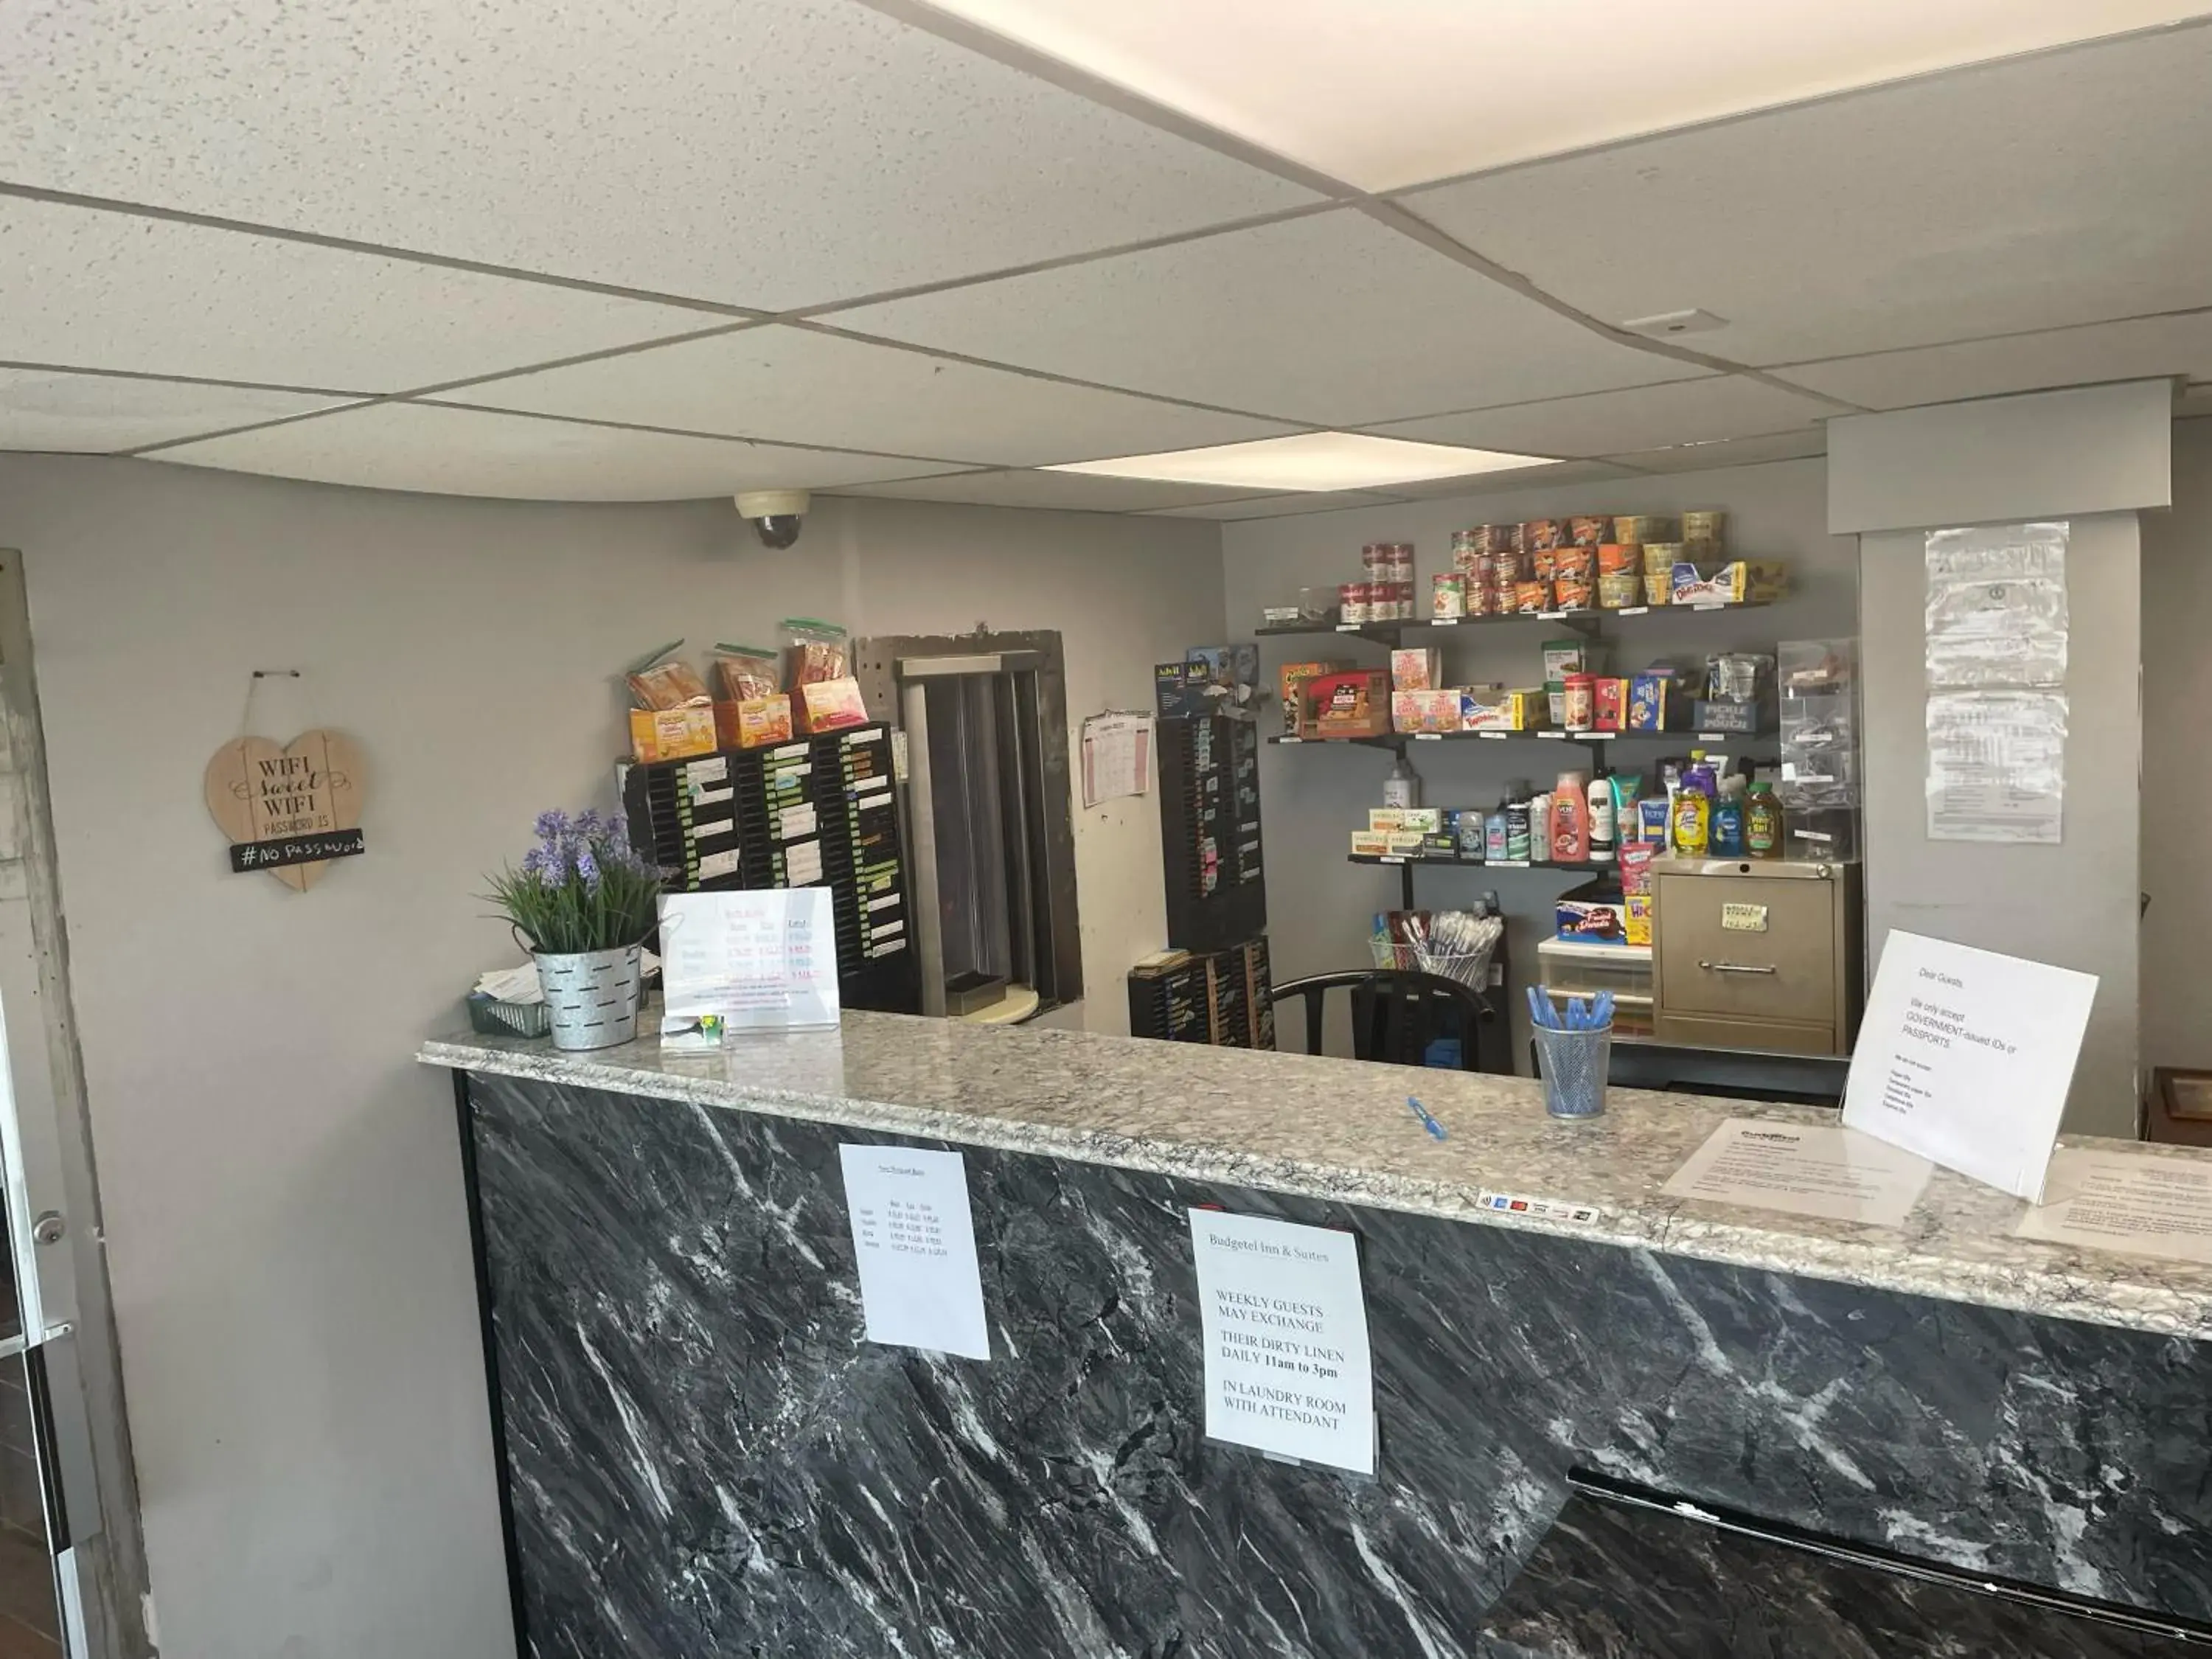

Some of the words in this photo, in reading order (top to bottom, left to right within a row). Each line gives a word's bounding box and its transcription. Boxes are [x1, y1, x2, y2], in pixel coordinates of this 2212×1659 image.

[258, 755, 310, 776] WIFI
[264, 794, 316, 816] WIFI
[263, 818, 313, 835] PASSWORD
[317, 815, 329, 827] IS
[1919, 967, 1936, 979] Dear
[1910, 997, 1922, 1008] We
[1924, 1003, 1938, 1015] only
[1940, 1009, 1965, 1023] accept
[1209, 1233, 1259, 1253] Budgetel
[1261, 1240, 1280, 1256] Inn
[1282, 1246, 1293, 1257] &
[1295, 1248, 1329, 1262] Suites
[1216, 1289, 1271, 1310] WEEKLY
[1273, 1299, 1324, 1318] GUESTS
[1218, 1306, 1248, 1321] MAY
[1251, 1313, 1324, 1333] EXCHANGE
[1221, 1330, 1259, 1348] THEIR
[1261, 1338, 1301, 1354] DIRTY
[1304, 1345, 1345, 1363] LINEN
[1221, 1347, 1261, 1365] DAILY
[1265, 1354, 1295, 1371] 11am
[1298, 1363, 1310, 1373] to
[1312, 1364, 1338, 1379] 3pm
[1223, 1380, 1238, 1393] IN
[1239, 1383, 1302, 1406] LAUNDRY
[1306, 1397, 1346, 1415] ROOM
[1224, 1397, 1256, 1414] WITH
[1259, 1404, 1340, 1430] ATTENDANT
